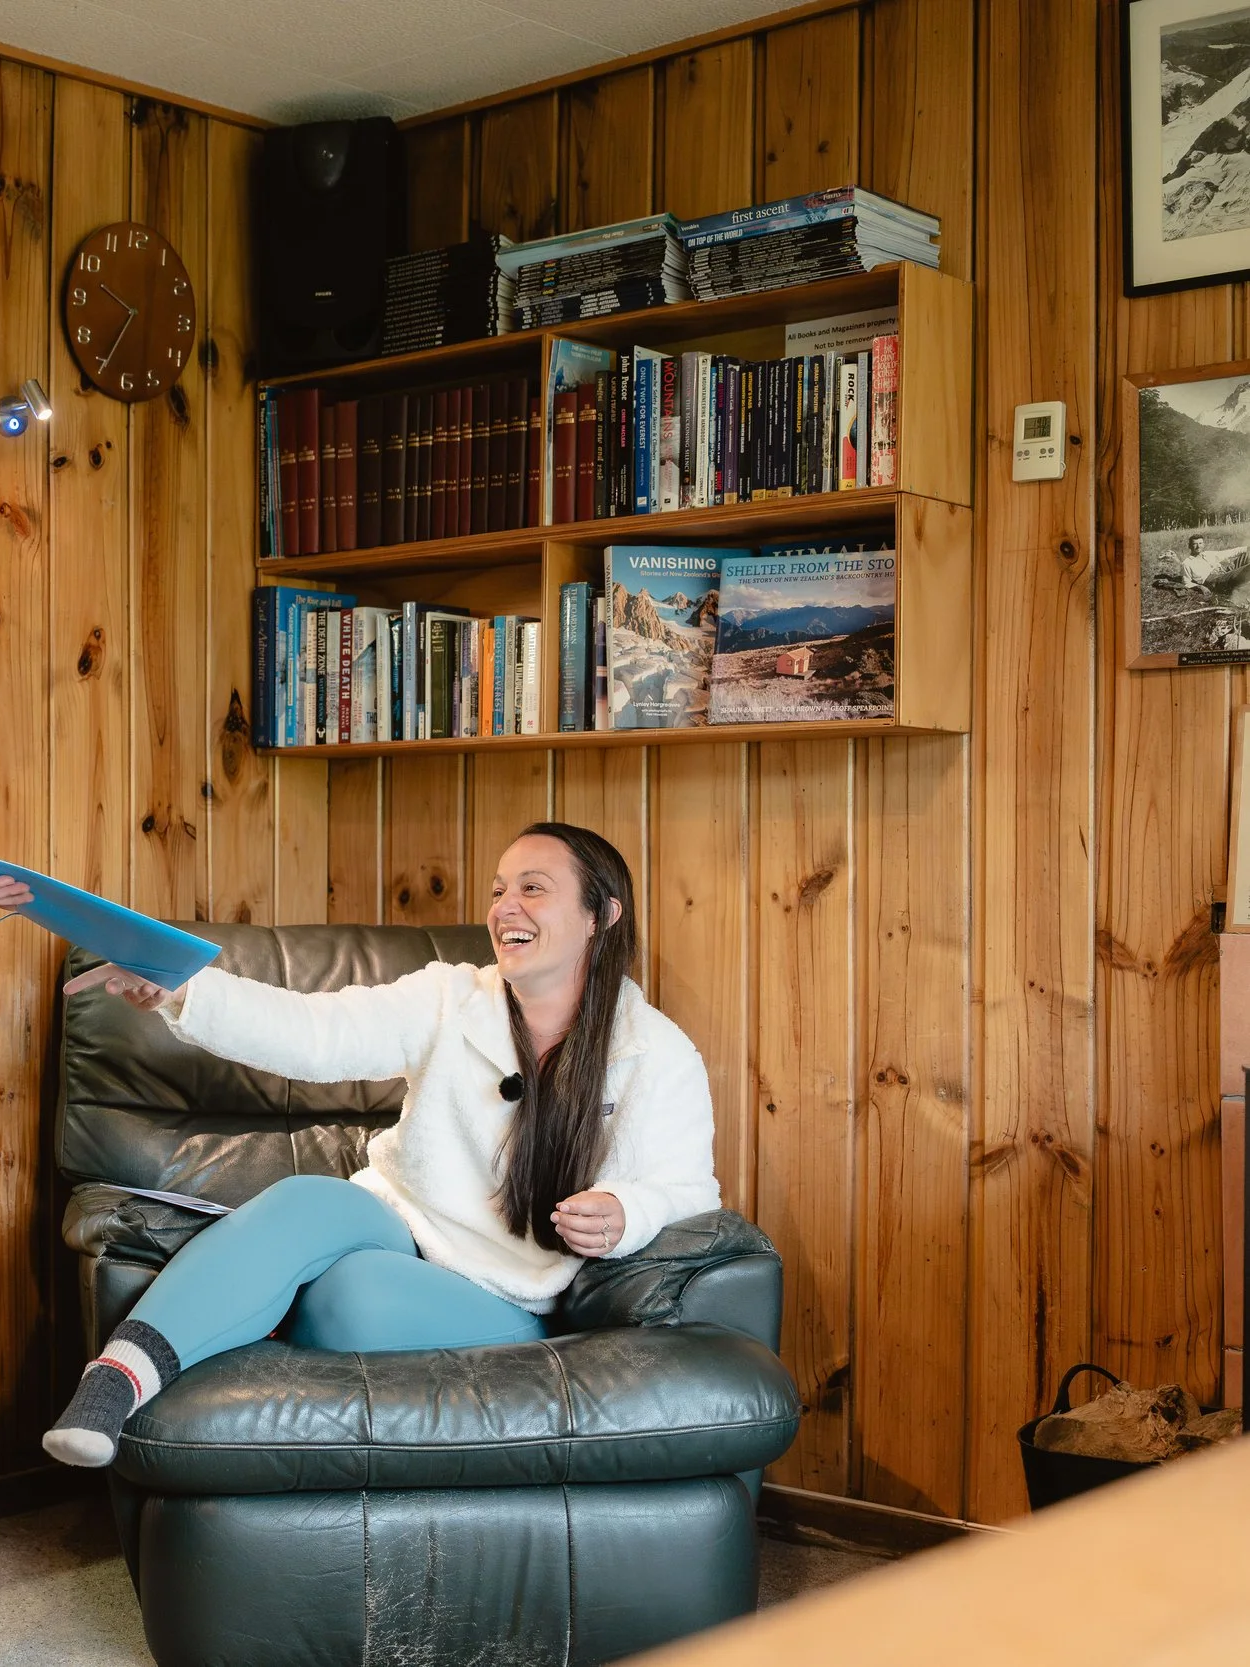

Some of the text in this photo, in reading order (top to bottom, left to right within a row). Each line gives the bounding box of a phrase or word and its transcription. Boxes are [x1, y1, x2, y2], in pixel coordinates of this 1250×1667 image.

[731, 203, 790, 224] first ascent
[106, 233, 118, 252] 11
[128, 230, 149, 250] 12
[687, 229, 743, 247] ON TOP OF THE WORLD
[80, 252, 101, 272] 10
[174, 277, 187, 296] 2
[73, 288, 87, 306] 9
[178, 315, 191, 332] 3
[787, 317, 896, 341] All Books and Magazines property
[77, 325, 91, 344] 8
[845, 335, 874, 345] removed
[168, 348, 182, 367] 4
[121, 372, 134, 391] 6
[147, 369, 160, 387] 5
[620, 355, 629, 401] John Pascoe
[662, 361, 674, 440] MOUNTAINS
[597, 447, 605, 462] and
[629, 556, 716, 570] VANISHING
[726, 563, 786, 577] SHELTER
[790, 561, 829, 575] FROM
[834, 559, 863, 572] THE
[867, 558, 895, 570] STO
[800, 574, 835, 582] ZEALAND'S
[836, 571, 883, 580] BACKCOUNTRY
[296, 594, 306, 604] The
[319, 597, 331, 606] and
[317, 611, 326, 675] THE DEATH ZONE
[528, 627, 536, 662] MATTHEW
[257, 628, 268, 681] Adventure
[341, 614, 351, 699] WHITE DEATH
[494, 675, 502, 713] EVEREST
[720, 706, 742, 714] SHAUN
